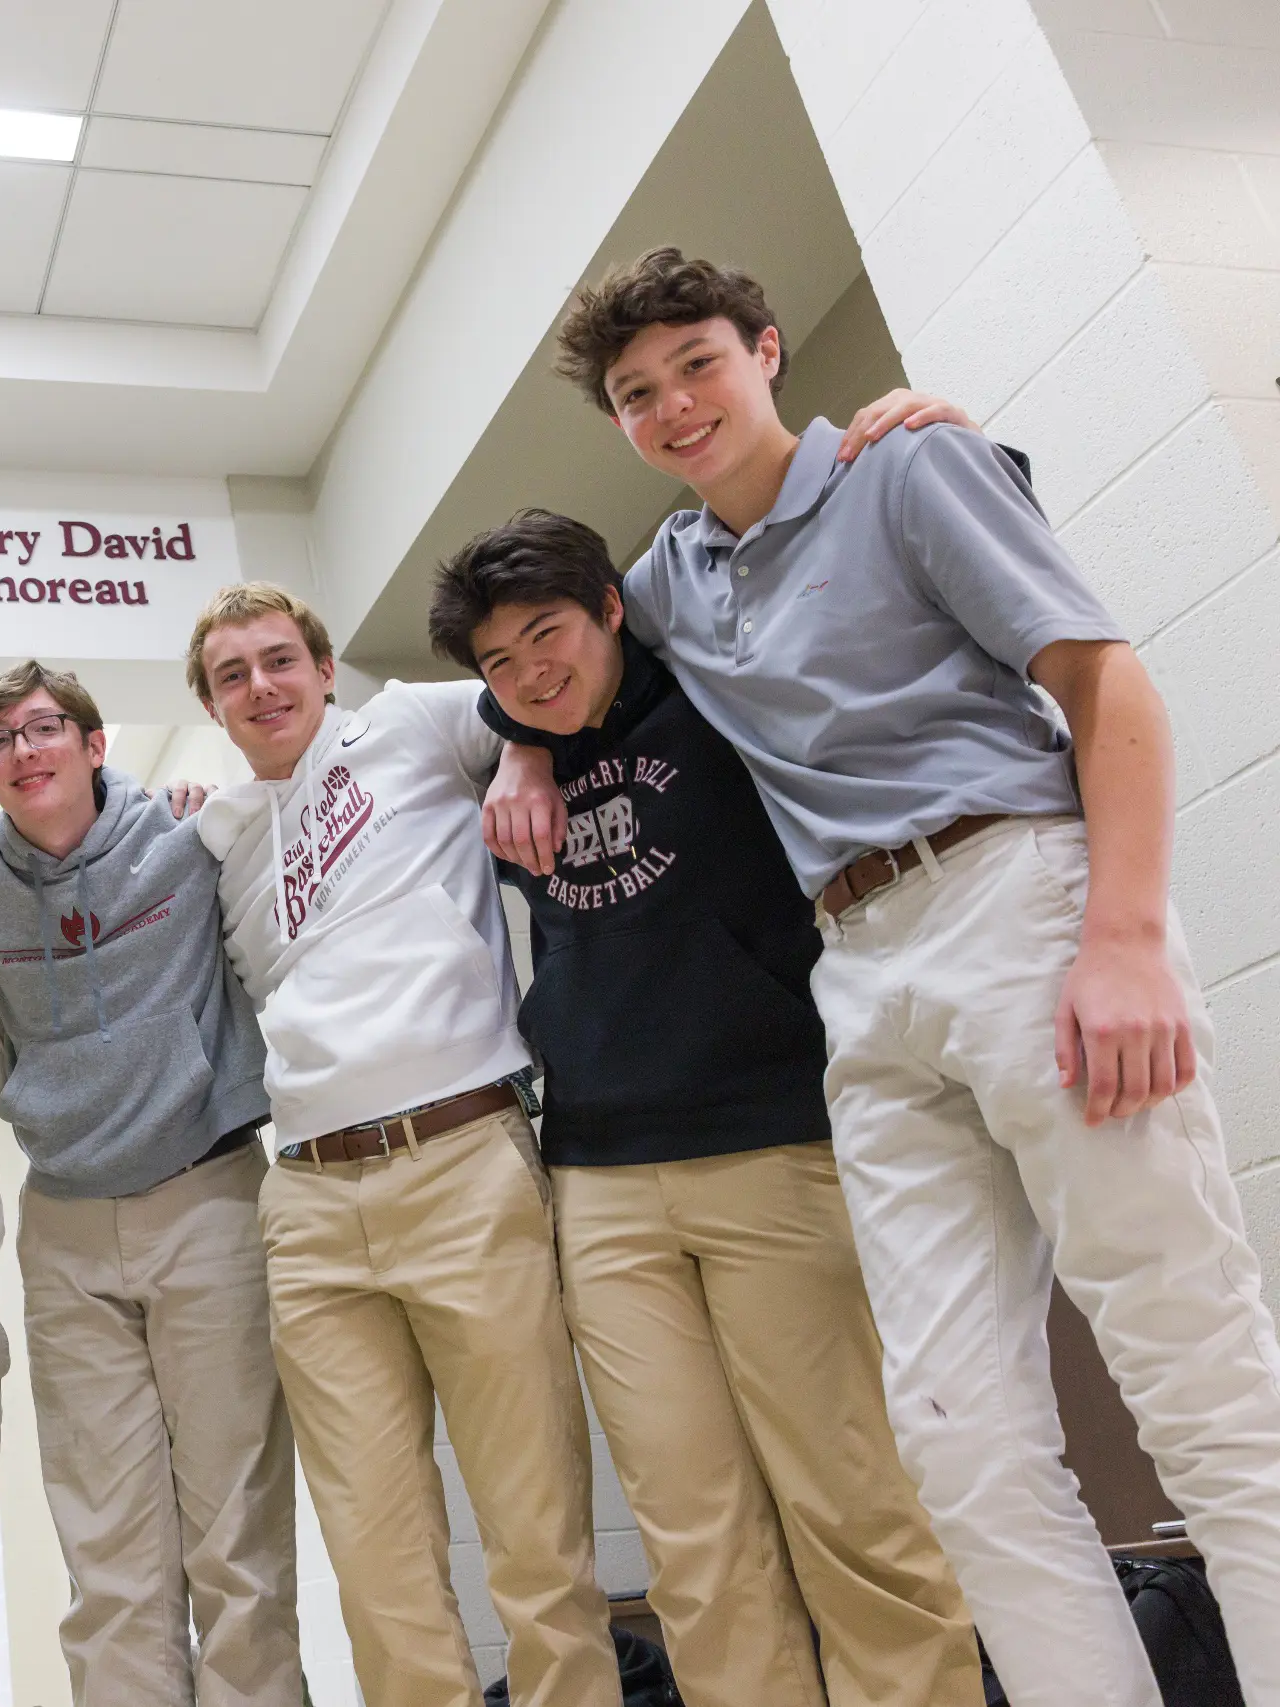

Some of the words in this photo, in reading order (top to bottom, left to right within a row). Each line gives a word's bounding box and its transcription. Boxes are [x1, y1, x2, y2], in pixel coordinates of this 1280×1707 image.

[58, 521, 196, 560] David
[634, 756, 679, 793] BELL
[314, 832, 371, 912] MONTGOMERY
[373, 805, 399, 834] BELL
[547, 847, 677, 910] BASKETBALL
